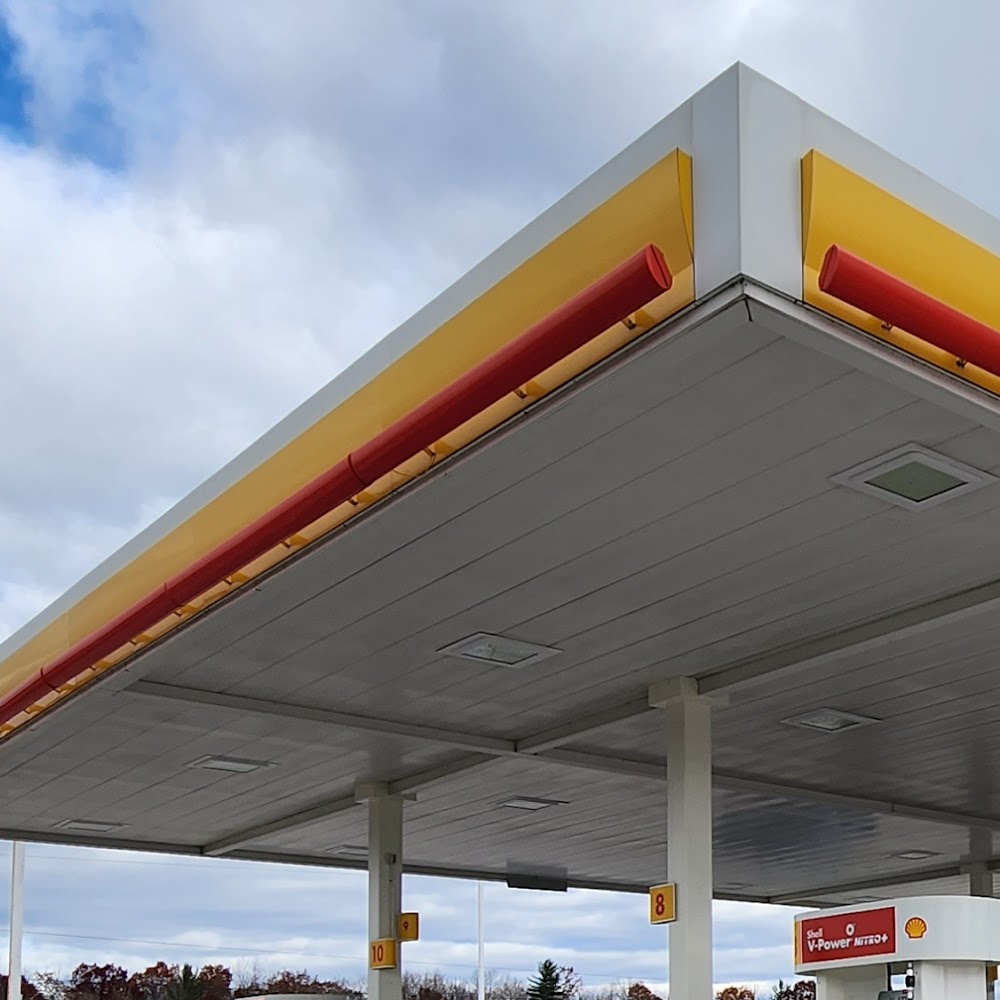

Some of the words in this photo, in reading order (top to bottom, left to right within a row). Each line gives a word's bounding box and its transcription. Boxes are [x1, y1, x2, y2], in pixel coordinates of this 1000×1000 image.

[655, 893, 665, 916] 8
[806, 928, 823, 940] Shell
[807, 938, 852, 952] V-Power
[372, 945, 384, 963] 10
